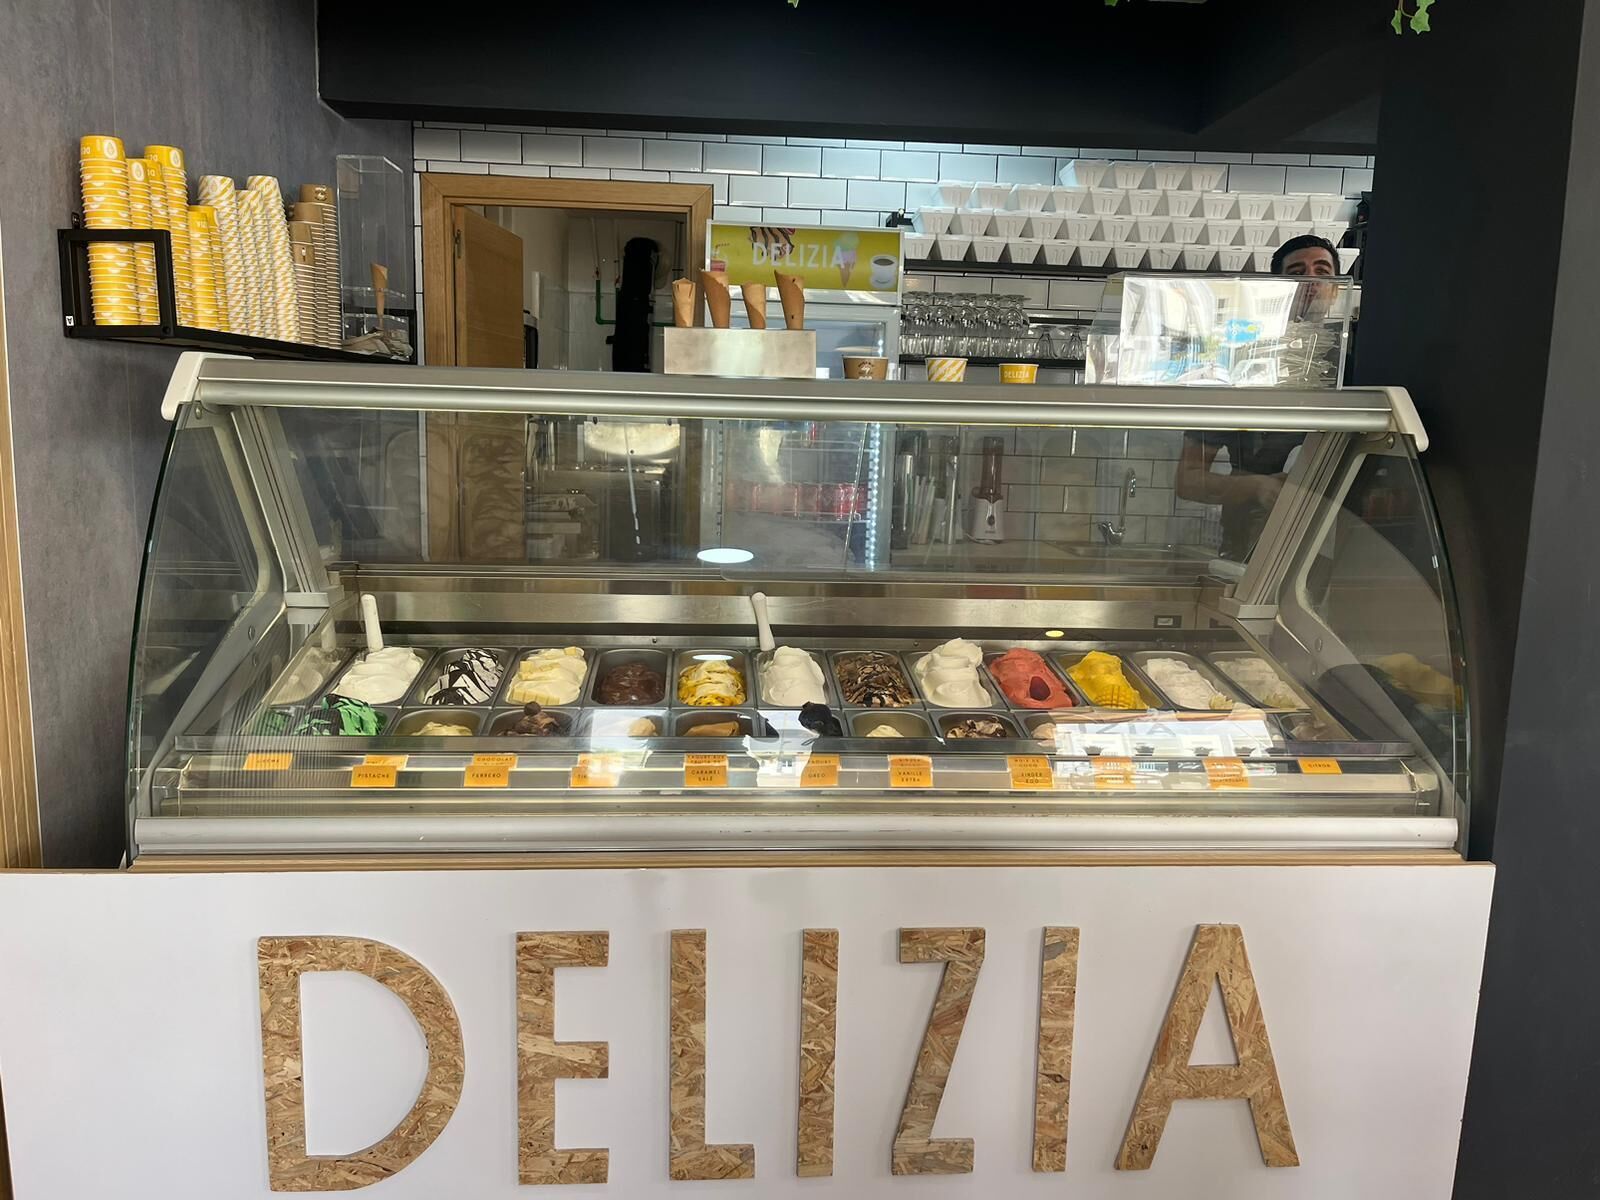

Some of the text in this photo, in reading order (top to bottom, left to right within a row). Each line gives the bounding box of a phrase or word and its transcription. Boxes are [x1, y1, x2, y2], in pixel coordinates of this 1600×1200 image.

[752, 241, 846, 269] DELIZIA
[1003, 370, 1030, 378] DELIZIA
[257, 923, 1300, 1191] DELIZIA
